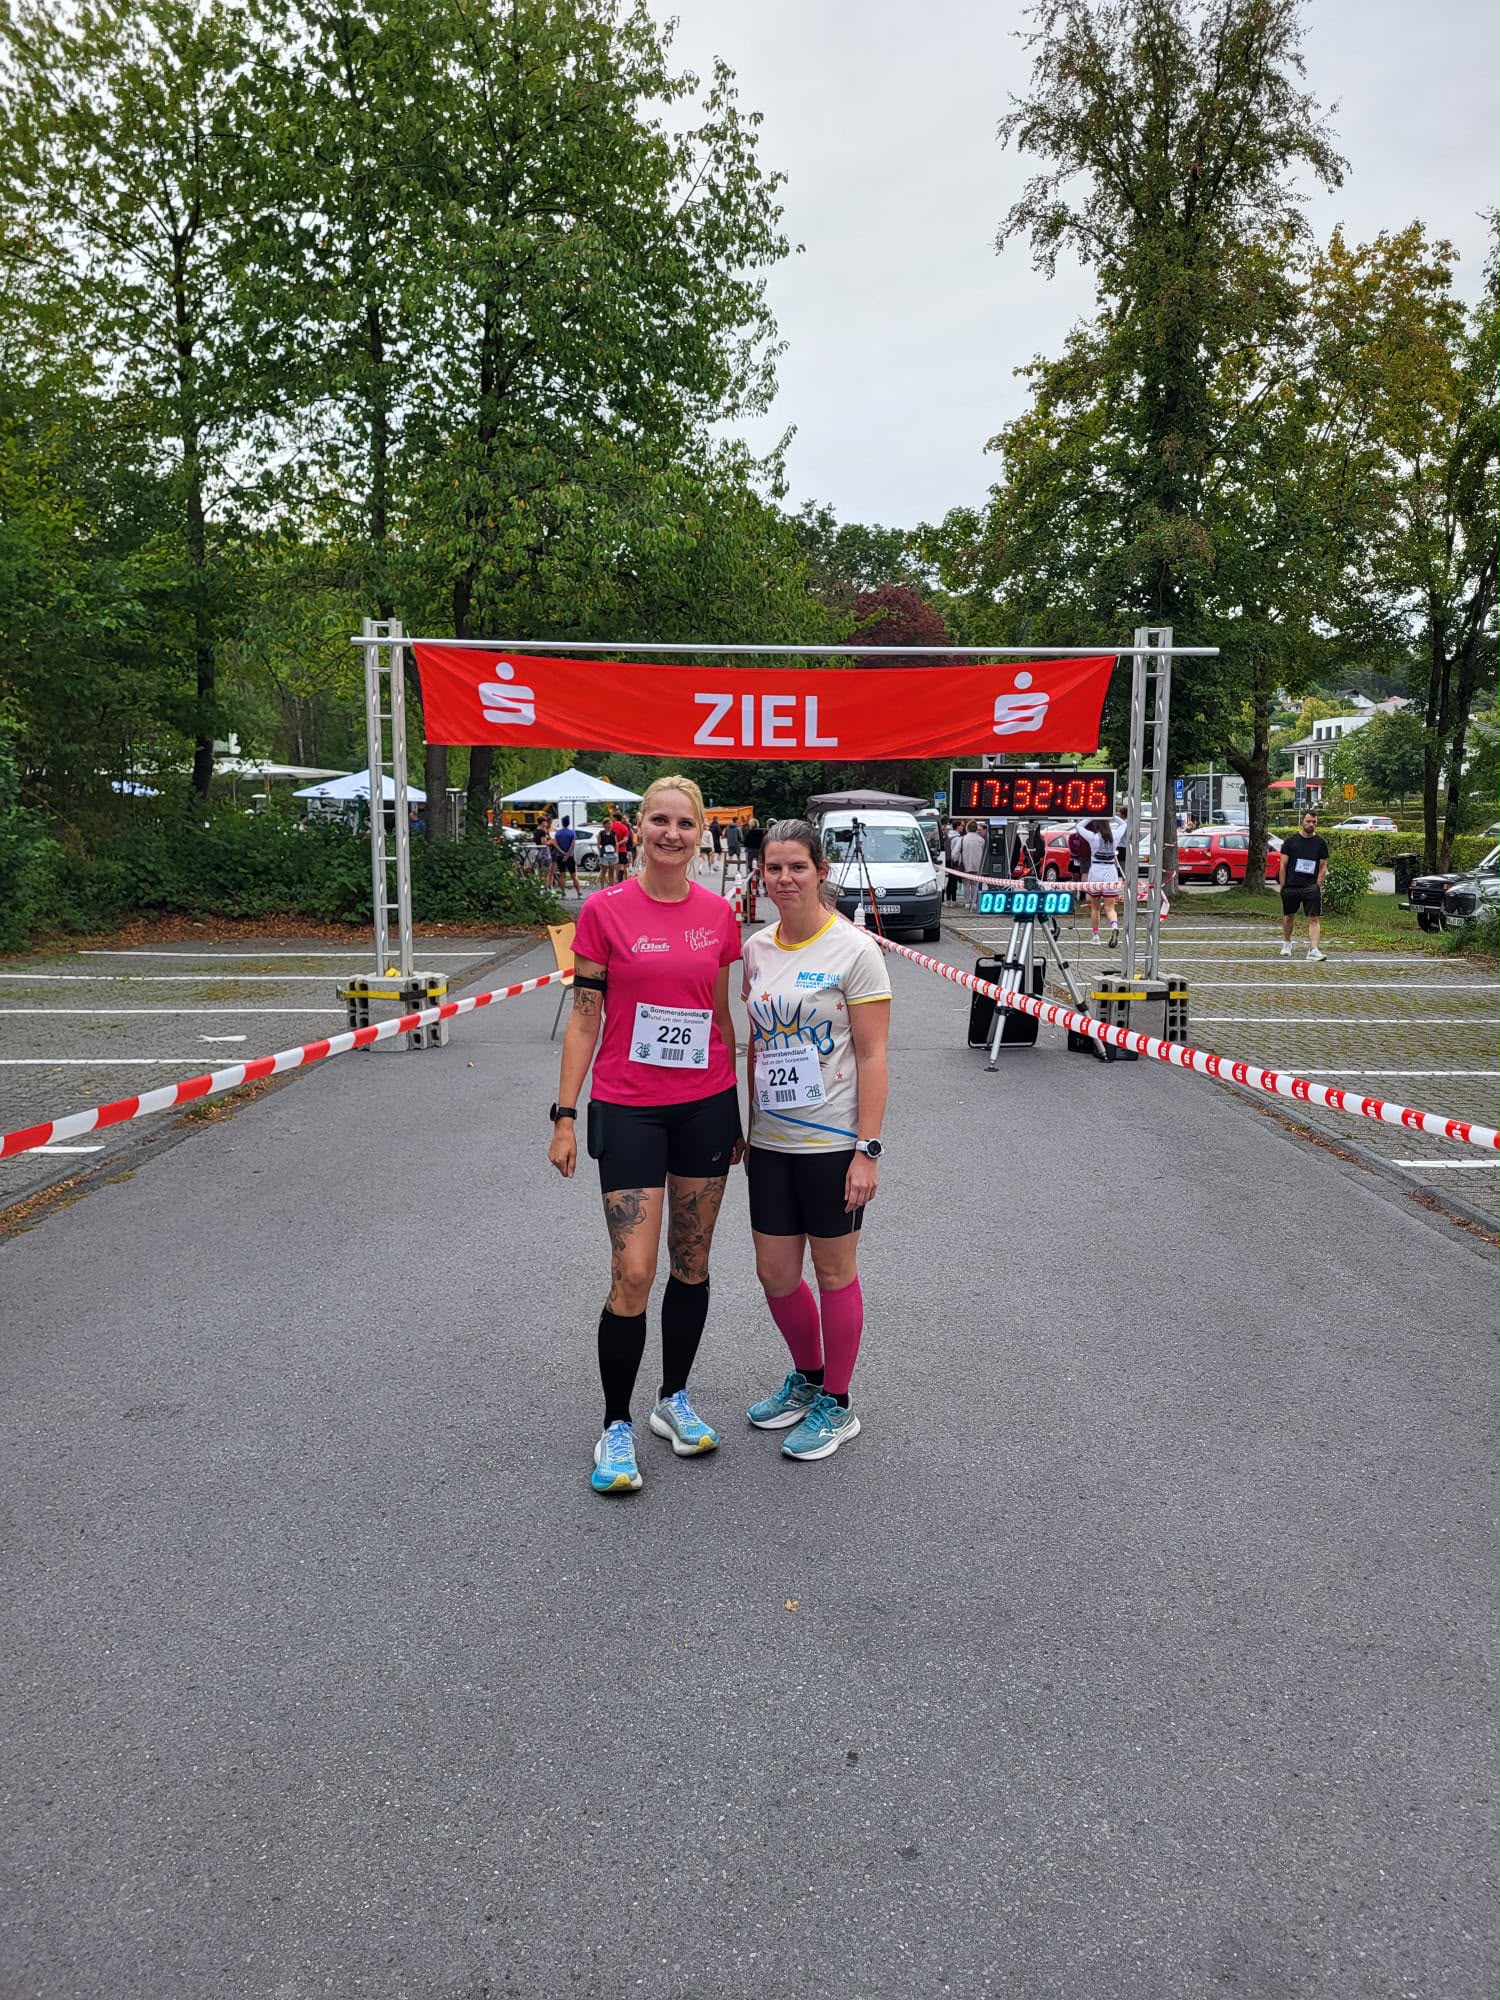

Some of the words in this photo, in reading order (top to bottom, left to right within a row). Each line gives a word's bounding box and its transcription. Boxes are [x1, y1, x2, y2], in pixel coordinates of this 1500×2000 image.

[694, 692, 838, 748] ZIEL
[971, 780, 1106, 809] 17:32:06
[980, 893, 1071, 913] 00:00:00
[797, 971, 825, 981] NICE
[650, 1006, 704, 1018] Sommerabendlau
[657, 1025, 692, 1045] 226
[768, 1066, 799, 1087] 224
